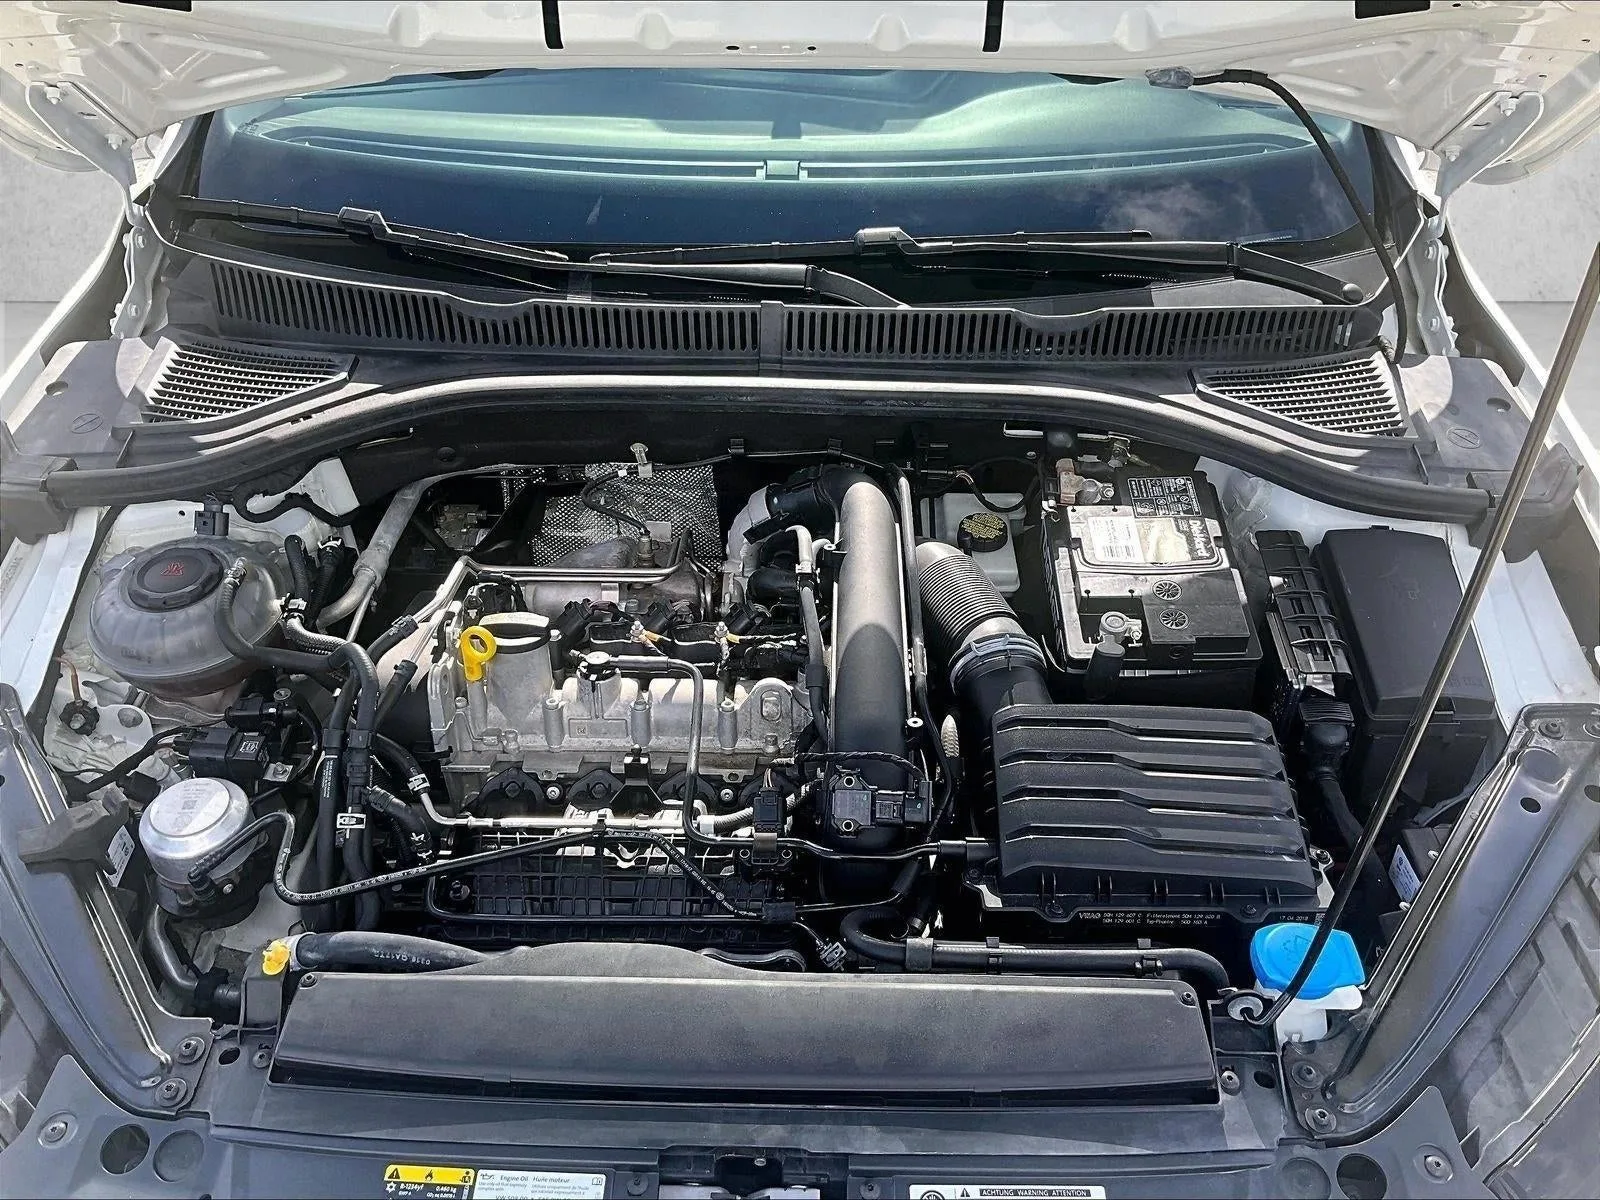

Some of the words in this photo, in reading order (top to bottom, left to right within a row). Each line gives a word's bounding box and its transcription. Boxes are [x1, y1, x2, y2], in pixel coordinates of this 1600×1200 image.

[500, 1174, 519, 1182] Engine
[1017, 1189, 1049, 1197] WARNING
[1051, 1189, 1087, 1197] ATTENTION
